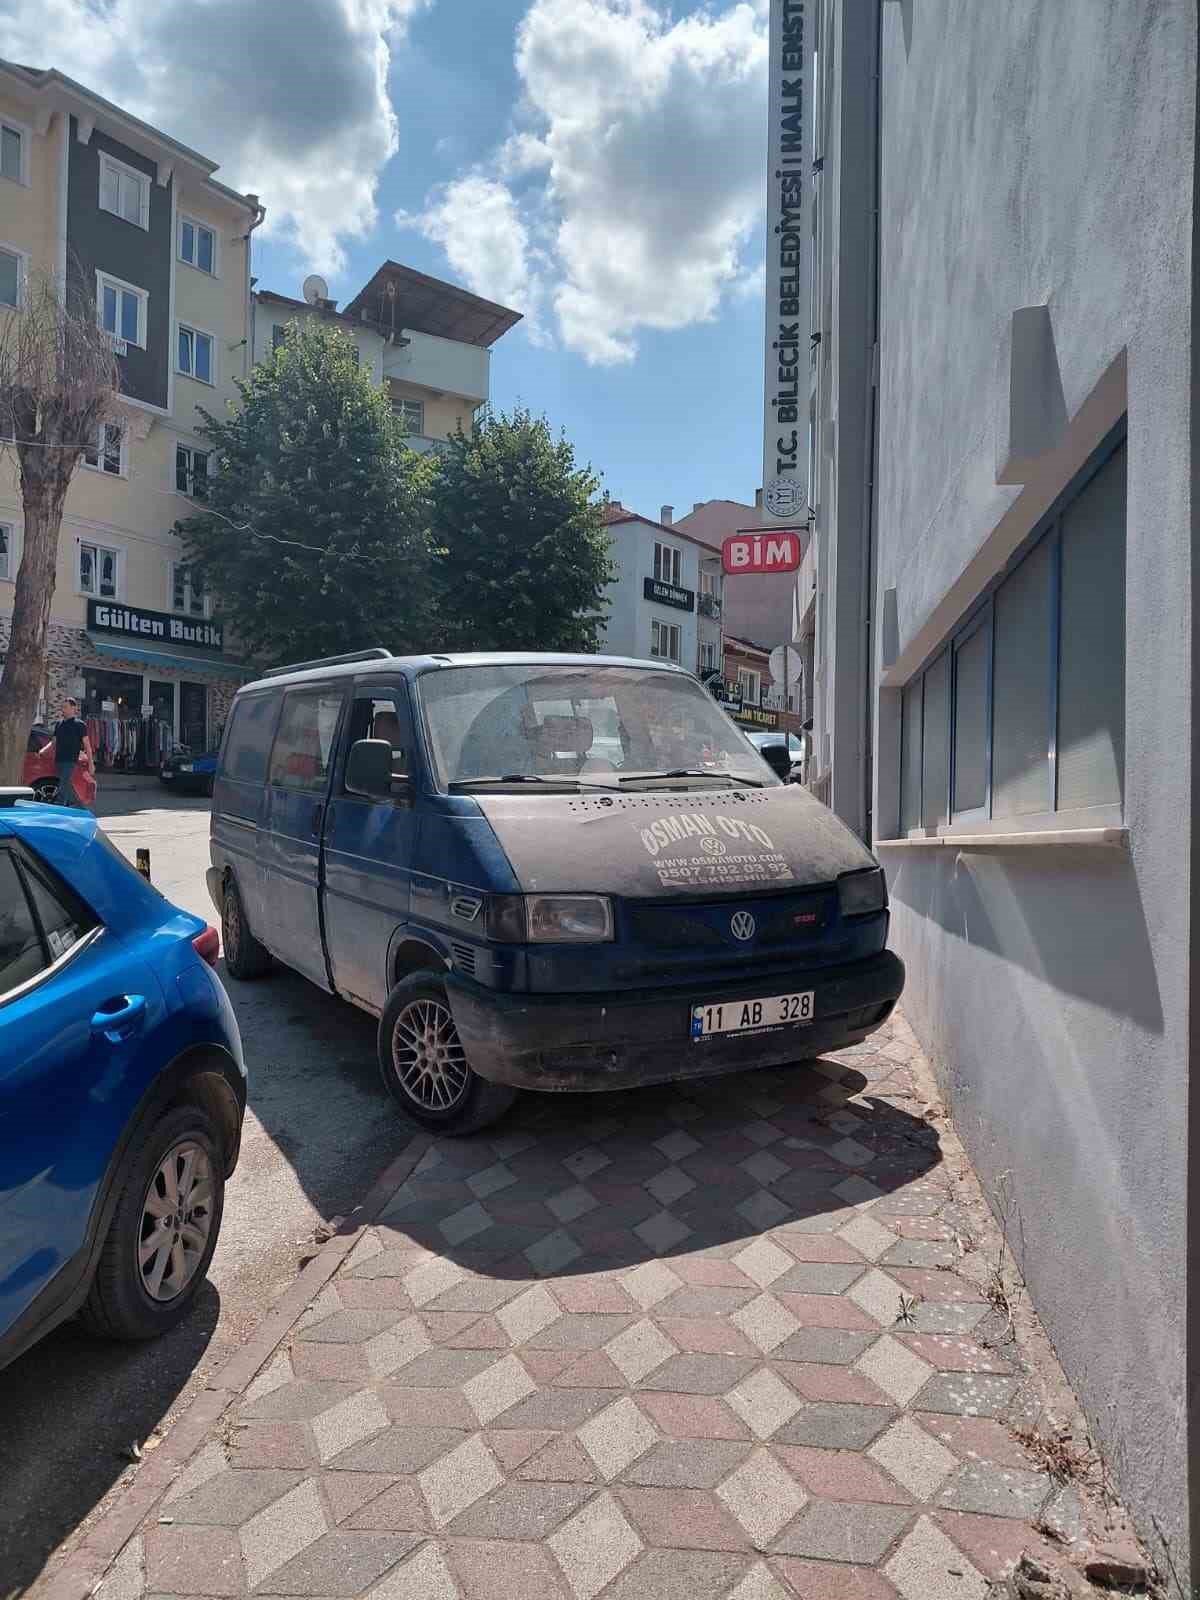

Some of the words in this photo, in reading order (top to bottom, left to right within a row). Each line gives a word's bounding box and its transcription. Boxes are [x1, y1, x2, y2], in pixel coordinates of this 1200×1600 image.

[781, 77, 803, 152] HALK
[774, 170, 801, 316] BELEDİYESİ
[772, 322, 800, 423] BİLECİK
[776, 430, 798, 474] T.C.
[730, 536, 792, 567] BİM
[95, 605, 164, 636] Gülten
[170, 619, 221, 646] Butik
[640, 813, 719, 856] OSMAN
[715, 815, 774, 850] OTO
[657, 867, 700, 878] 0507
[706, 865, 739, 875] 792
[744, 863, 765, 873] 03
[767, 862, 789, 872] 92
[706, 1007, 722, 1030] 11
[740, 1002, 762, 1026] AB
[779, 995, 810, 1020] 328
